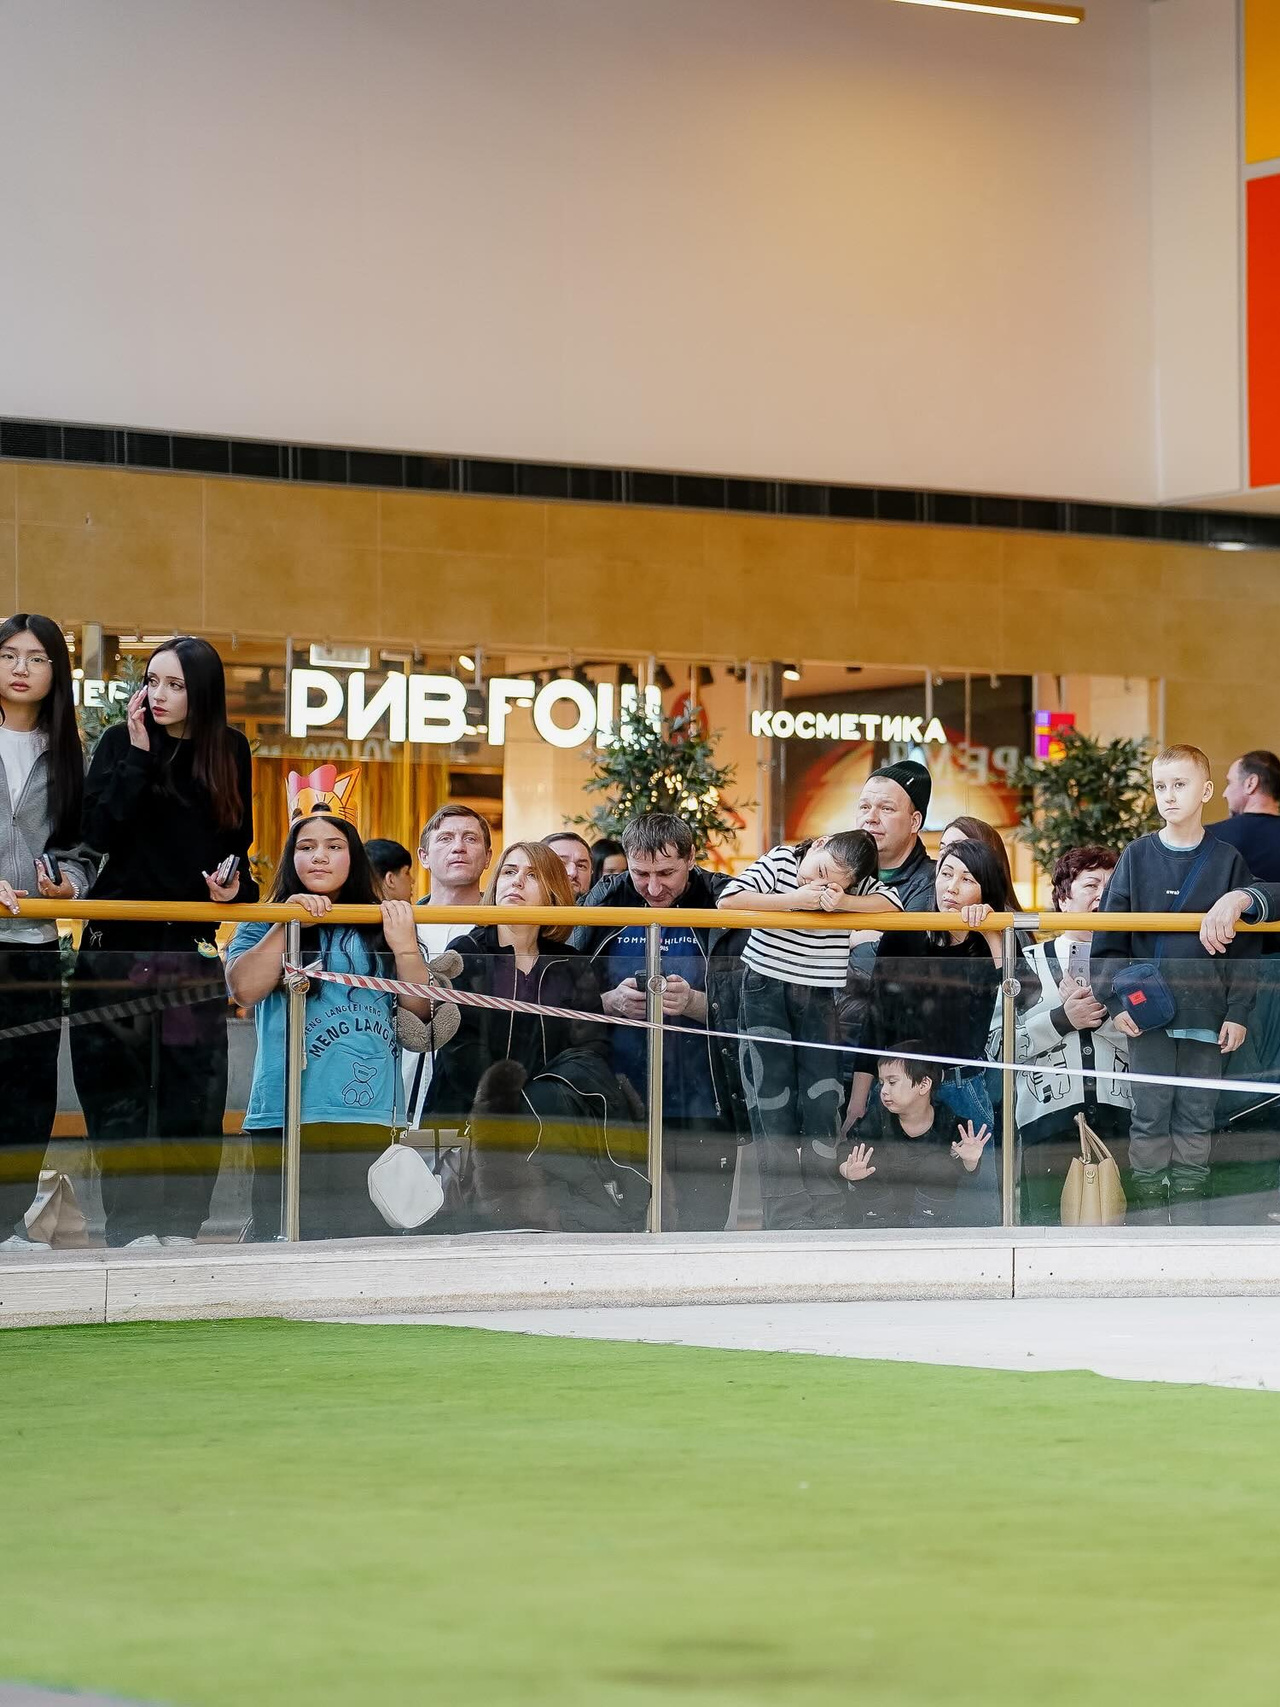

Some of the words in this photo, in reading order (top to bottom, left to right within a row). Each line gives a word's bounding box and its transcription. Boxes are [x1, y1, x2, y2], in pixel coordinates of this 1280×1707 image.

[290, 668, 467, 744] РИВ
[750, 709, 948, 744] КОСМЕТИКА
[617, 936, 646, 944] TOMM
[664, 936, 698, 945] HILFIGE
[308, 1021, 350, 1058] MENG
[355, 1017, 390, 1040] LANG
